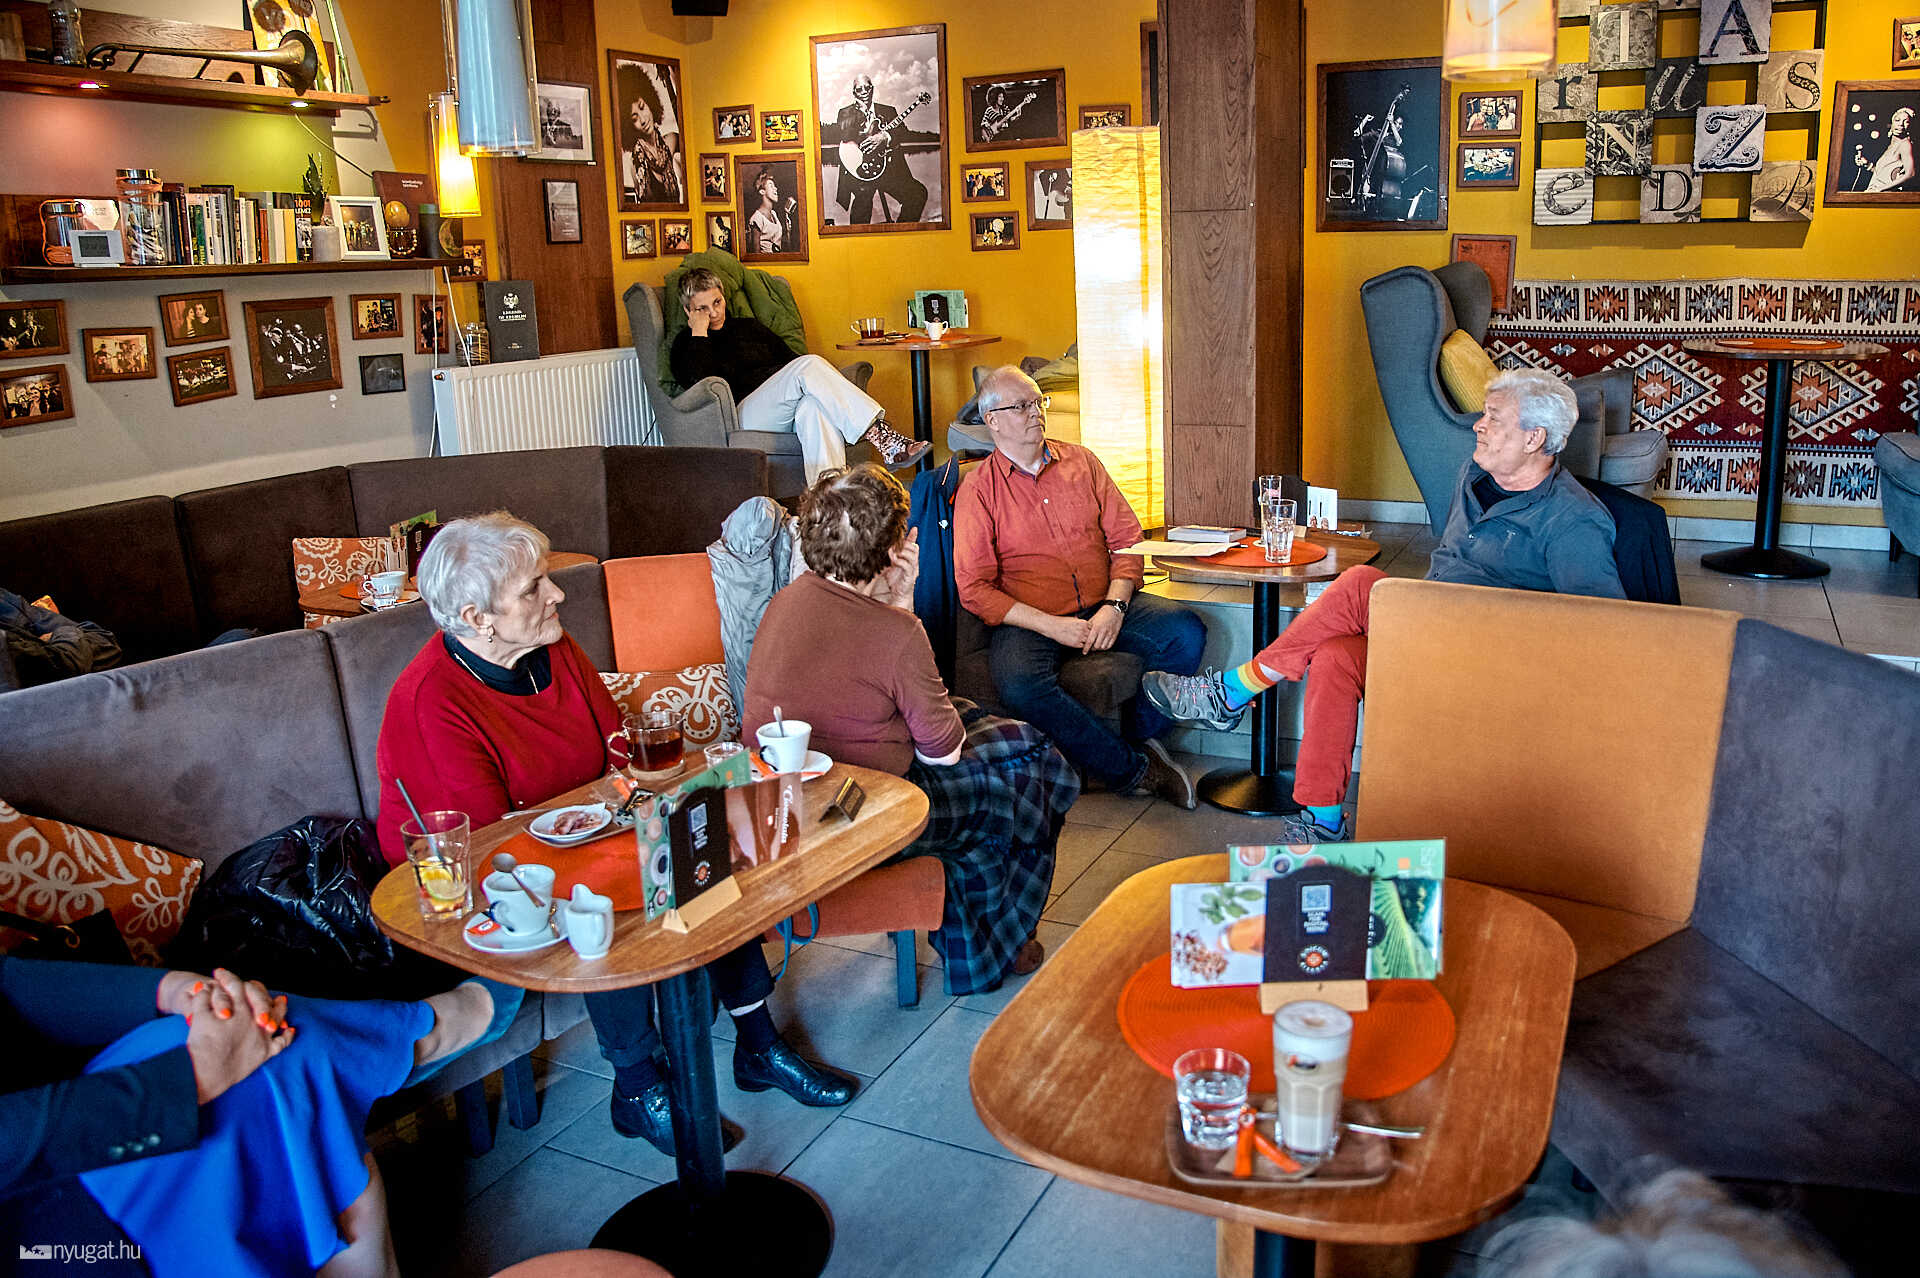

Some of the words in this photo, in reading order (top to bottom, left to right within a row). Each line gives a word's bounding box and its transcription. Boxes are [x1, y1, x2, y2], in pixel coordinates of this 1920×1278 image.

[1700, 0, 1768, 58] A
[1553, 75, 1583, 110] r
[1651, 64, 1701, 112] u
[1785, 61, 1820, 110] S
[1596, 119, 1641, 163] N
[1699, 108, 1765, 169] Z
[294, 199, 311, 208] 1001
[1543, 172, 1587, 216] e
[1650, 170, 1693, 212] D
